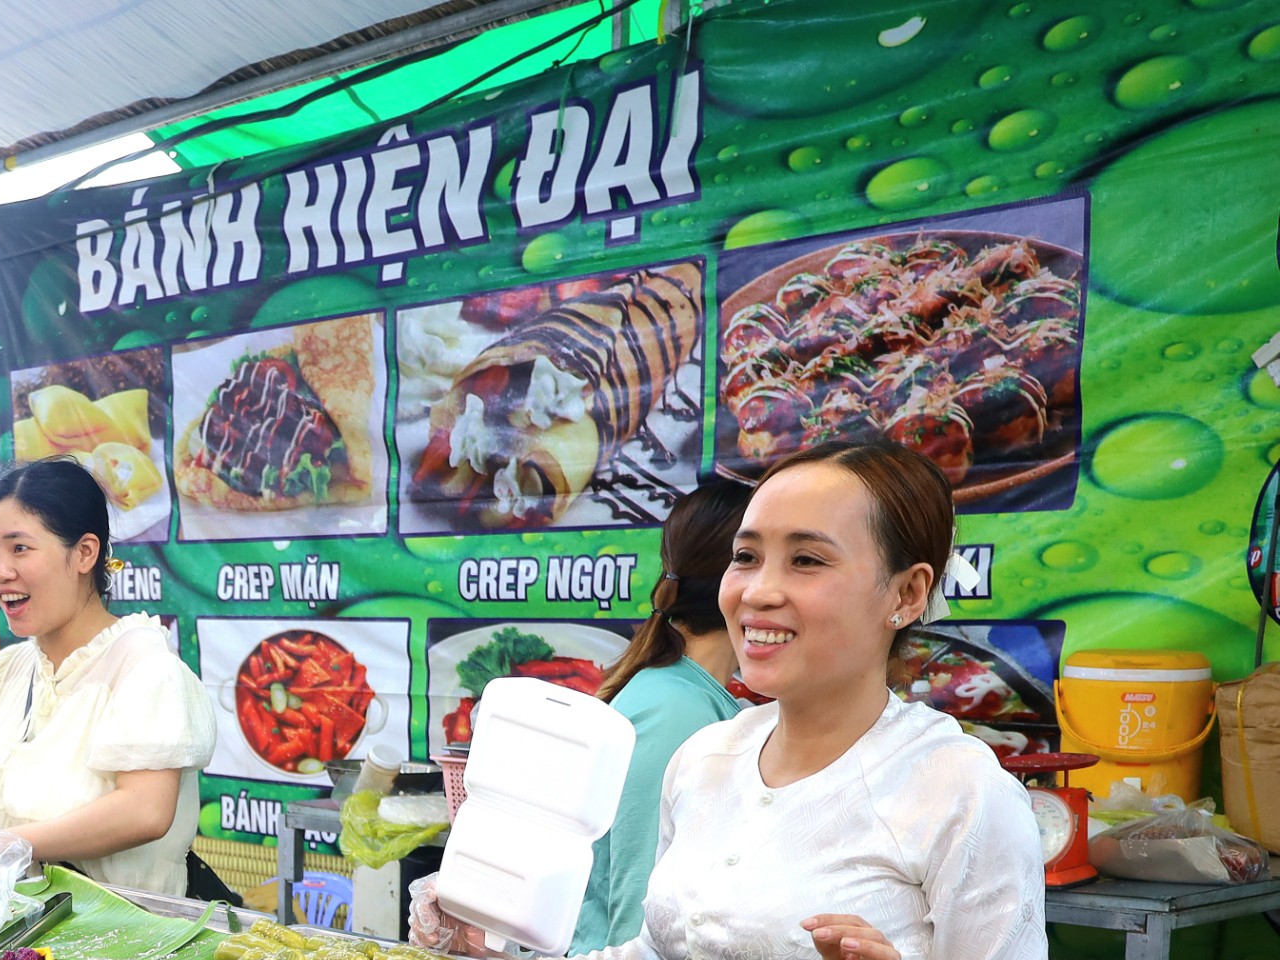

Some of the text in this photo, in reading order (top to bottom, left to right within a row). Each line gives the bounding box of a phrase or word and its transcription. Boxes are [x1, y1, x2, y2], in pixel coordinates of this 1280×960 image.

[77, 70, 701, 313] BÁNH HIỆN ĐẠI
[218, 556, 340, 608] CREP MẶN
[459, 555, 636, 609] CREP NGỌT
[221, 790, 283, 836] BÁNH
